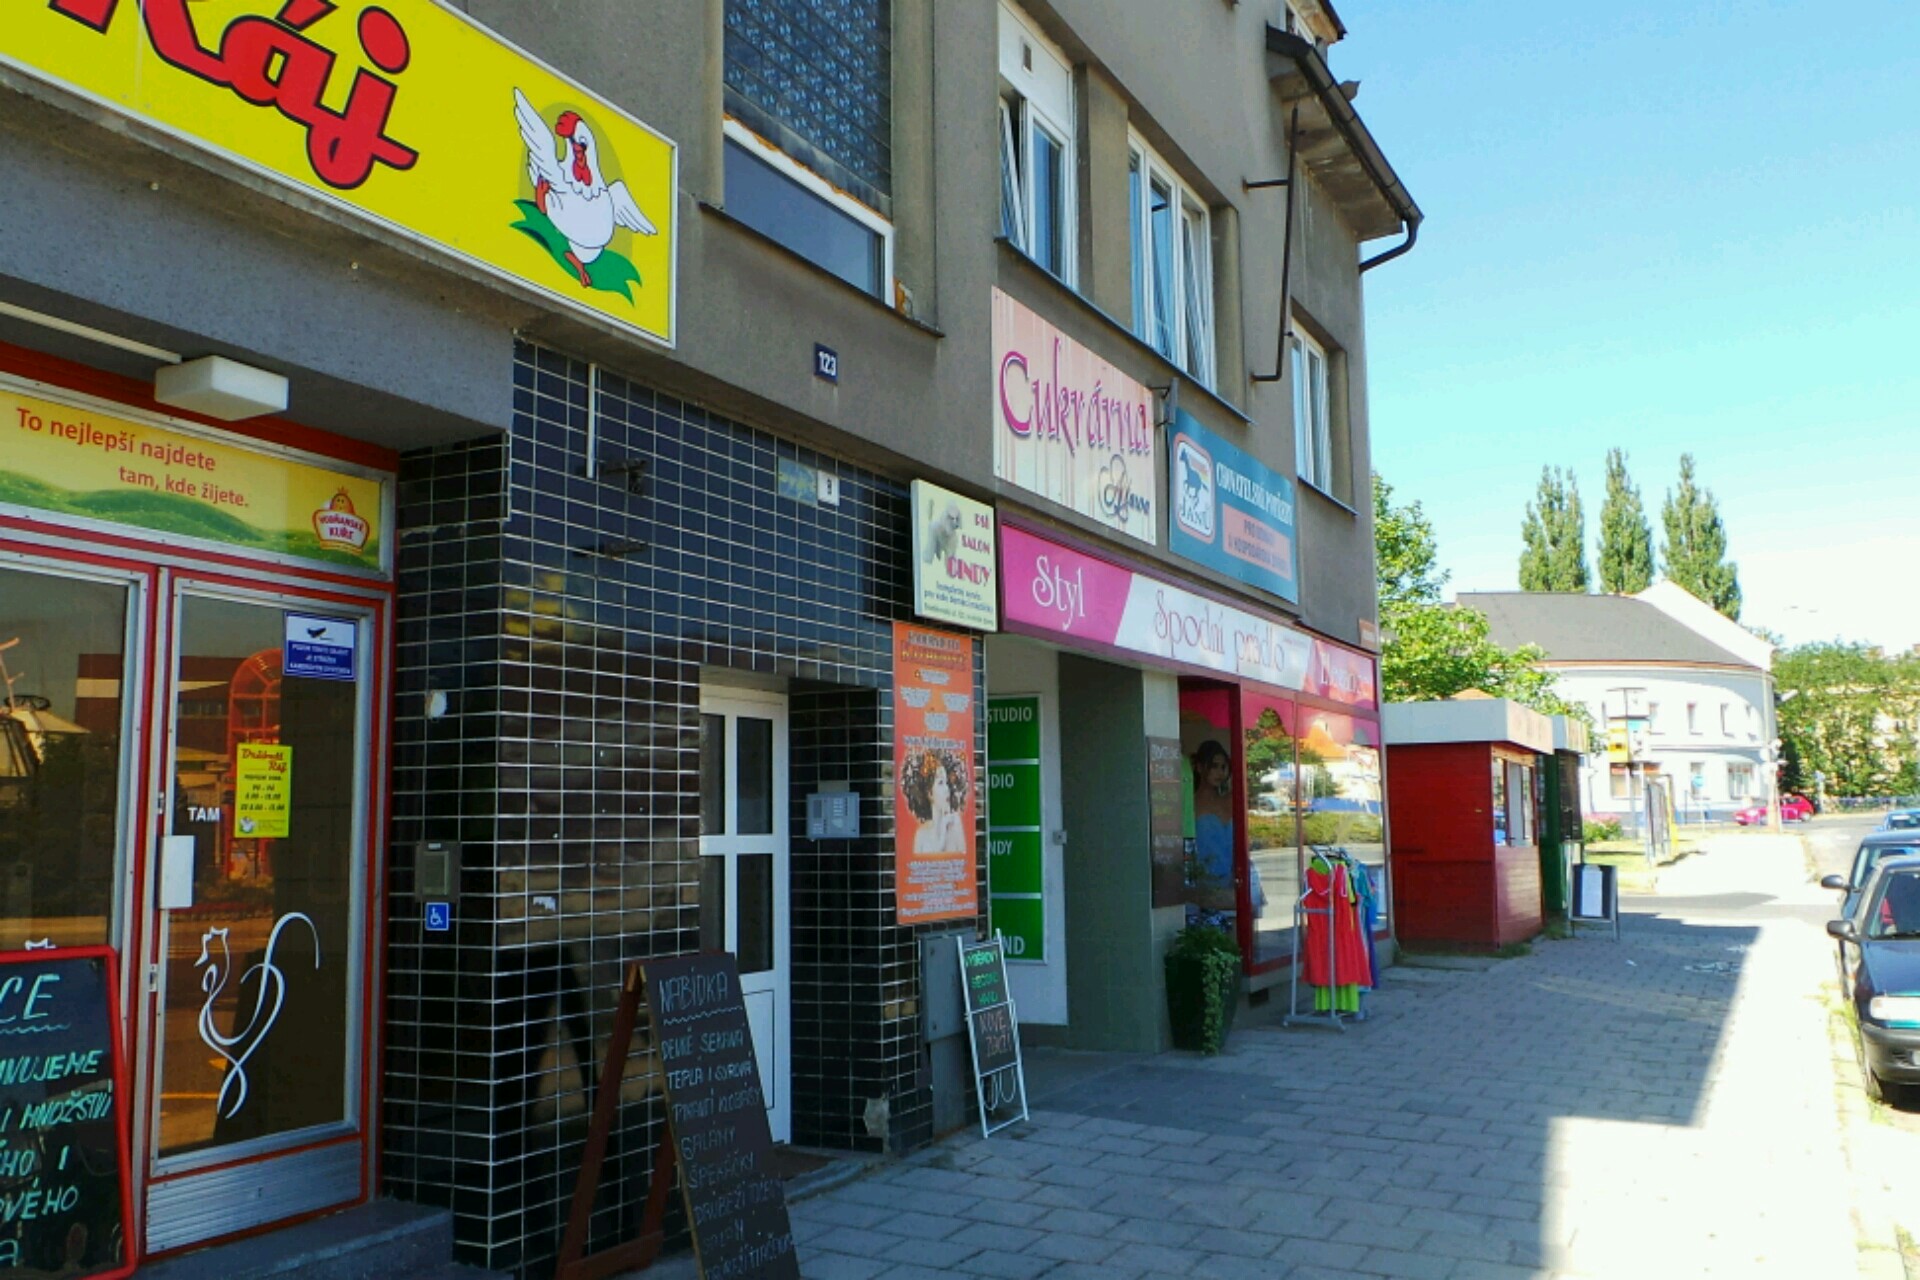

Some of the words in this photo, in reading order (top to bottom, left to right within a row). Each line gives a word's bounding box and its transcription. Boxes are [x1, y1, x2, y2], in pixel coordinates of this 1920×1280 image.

[50, 0, 418, 190] áj
[818, 351, 836, 377] 123
[17, 407, 43, 431] To
[50, 417, 136, 452] nejlepší
[140, 440, 216, 471] najdete
[118, 465, 159, 491] tam,
[165, 474, 196, 497] kde
[201, 480, 249, 508] žijete.
[1032, 555, 1085, 631] Styl
[1155, 590, 1225, 658] Spodní
[1234, 623, 1285, 672] prádlo
[988, 773, 1015, 789] DIO
[187, 807, 221, 822] TAM
[989, 840, 1013, 856] NDY
[996, 935, 1026, 955] ND
[0, 973, 60, 1024] CE
[658, 966, 728, 1014] NABÍDKA
[0, 1049, 104, 1086] NUJEME
[666, 1055, 703, 1090] TEPLÁ
[0, 1140, 36, 1177] HO
[58, 1145, 70, 1171] I
[681, 1120, 737, 1159] SALÁMY
[0, 1177, 79, 1222] VÉHO
